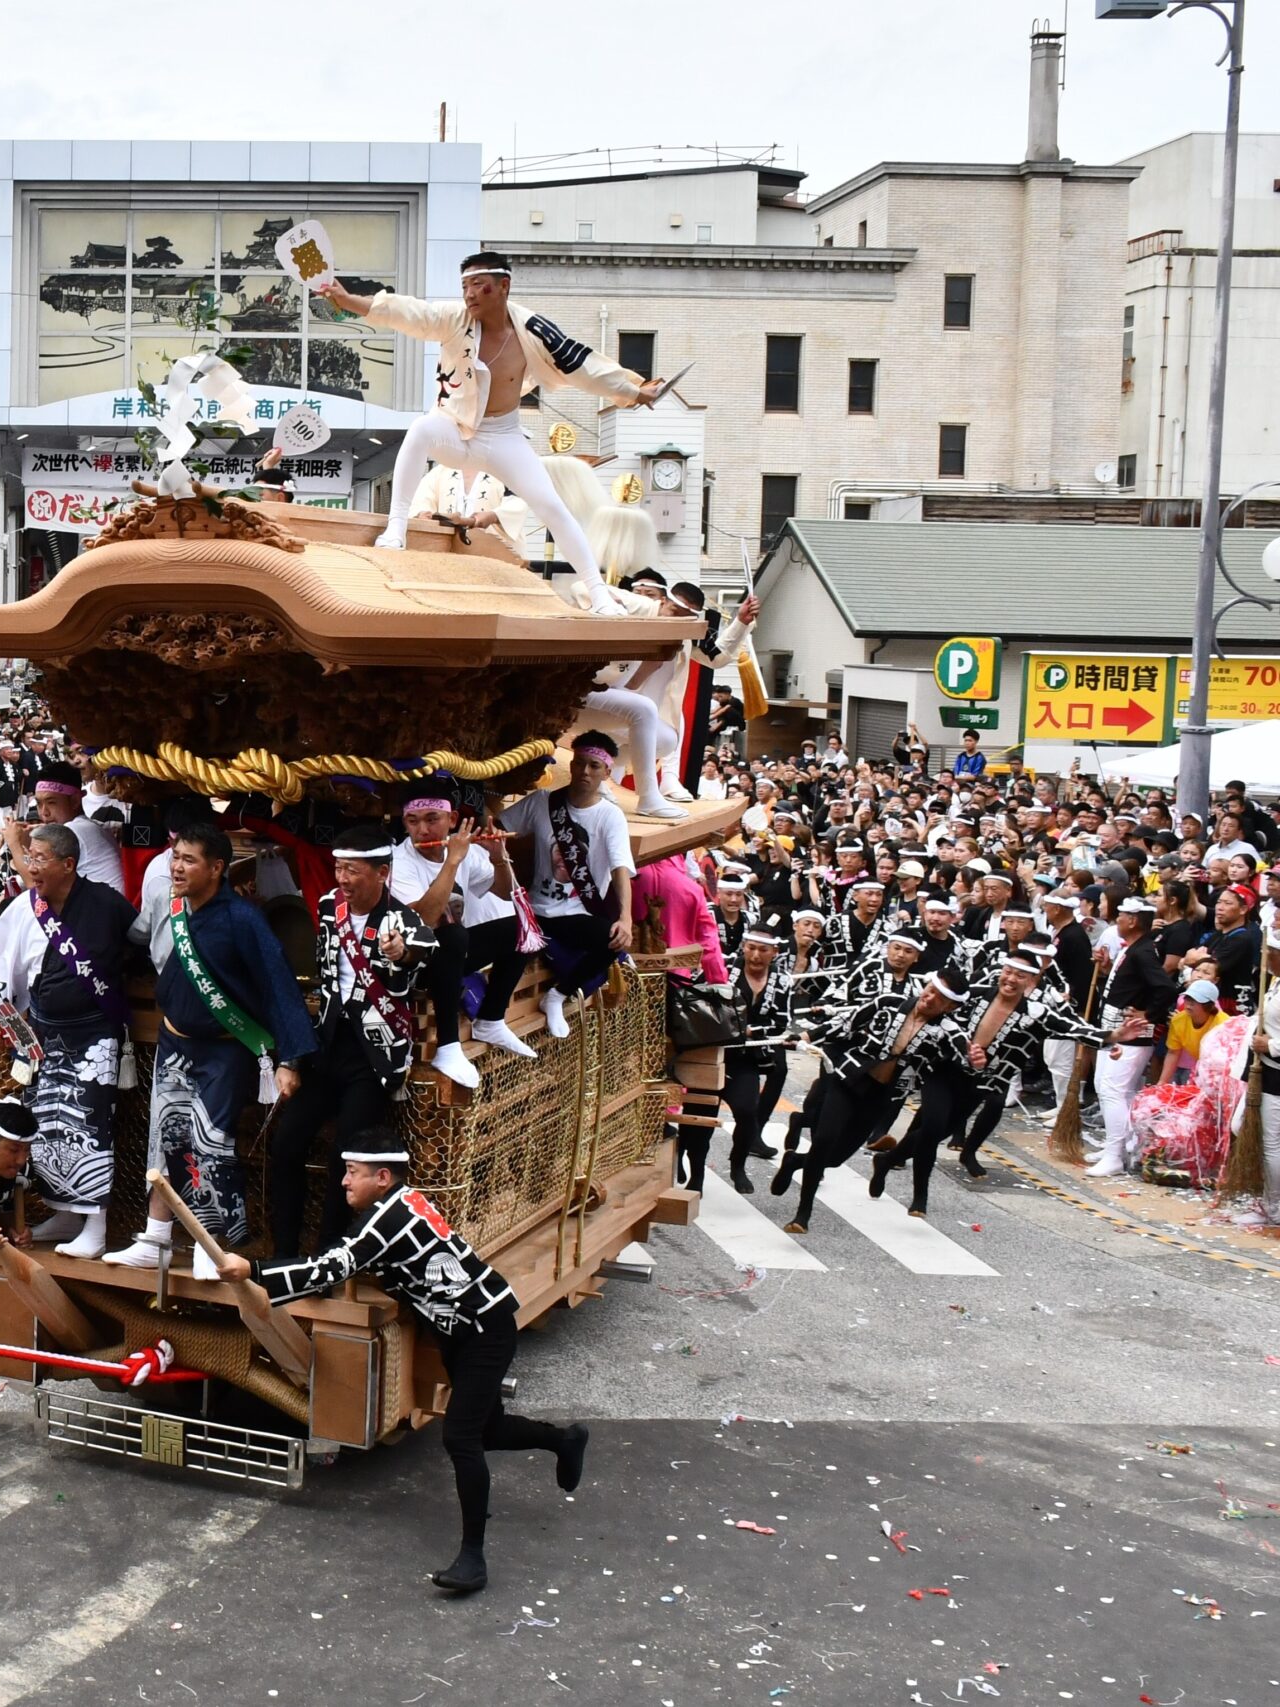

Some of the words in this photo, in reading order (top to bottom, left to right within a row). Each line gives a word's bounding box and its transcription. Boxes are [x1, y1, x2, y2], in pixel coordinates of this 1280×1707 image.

[292, 419, 316, 442] 100
[30, 491, 55, 521] 祝
[948, 650, 973, 687] P
[1049, 668, 1066, 687] P
[1075, 664, 1160, 693] 時間貸
[1033, 701, 1094, 730] 入口
[551, 805, 596, 900] 鳴物責任者
[173, 920, 227, 1010] 曳行責任者
